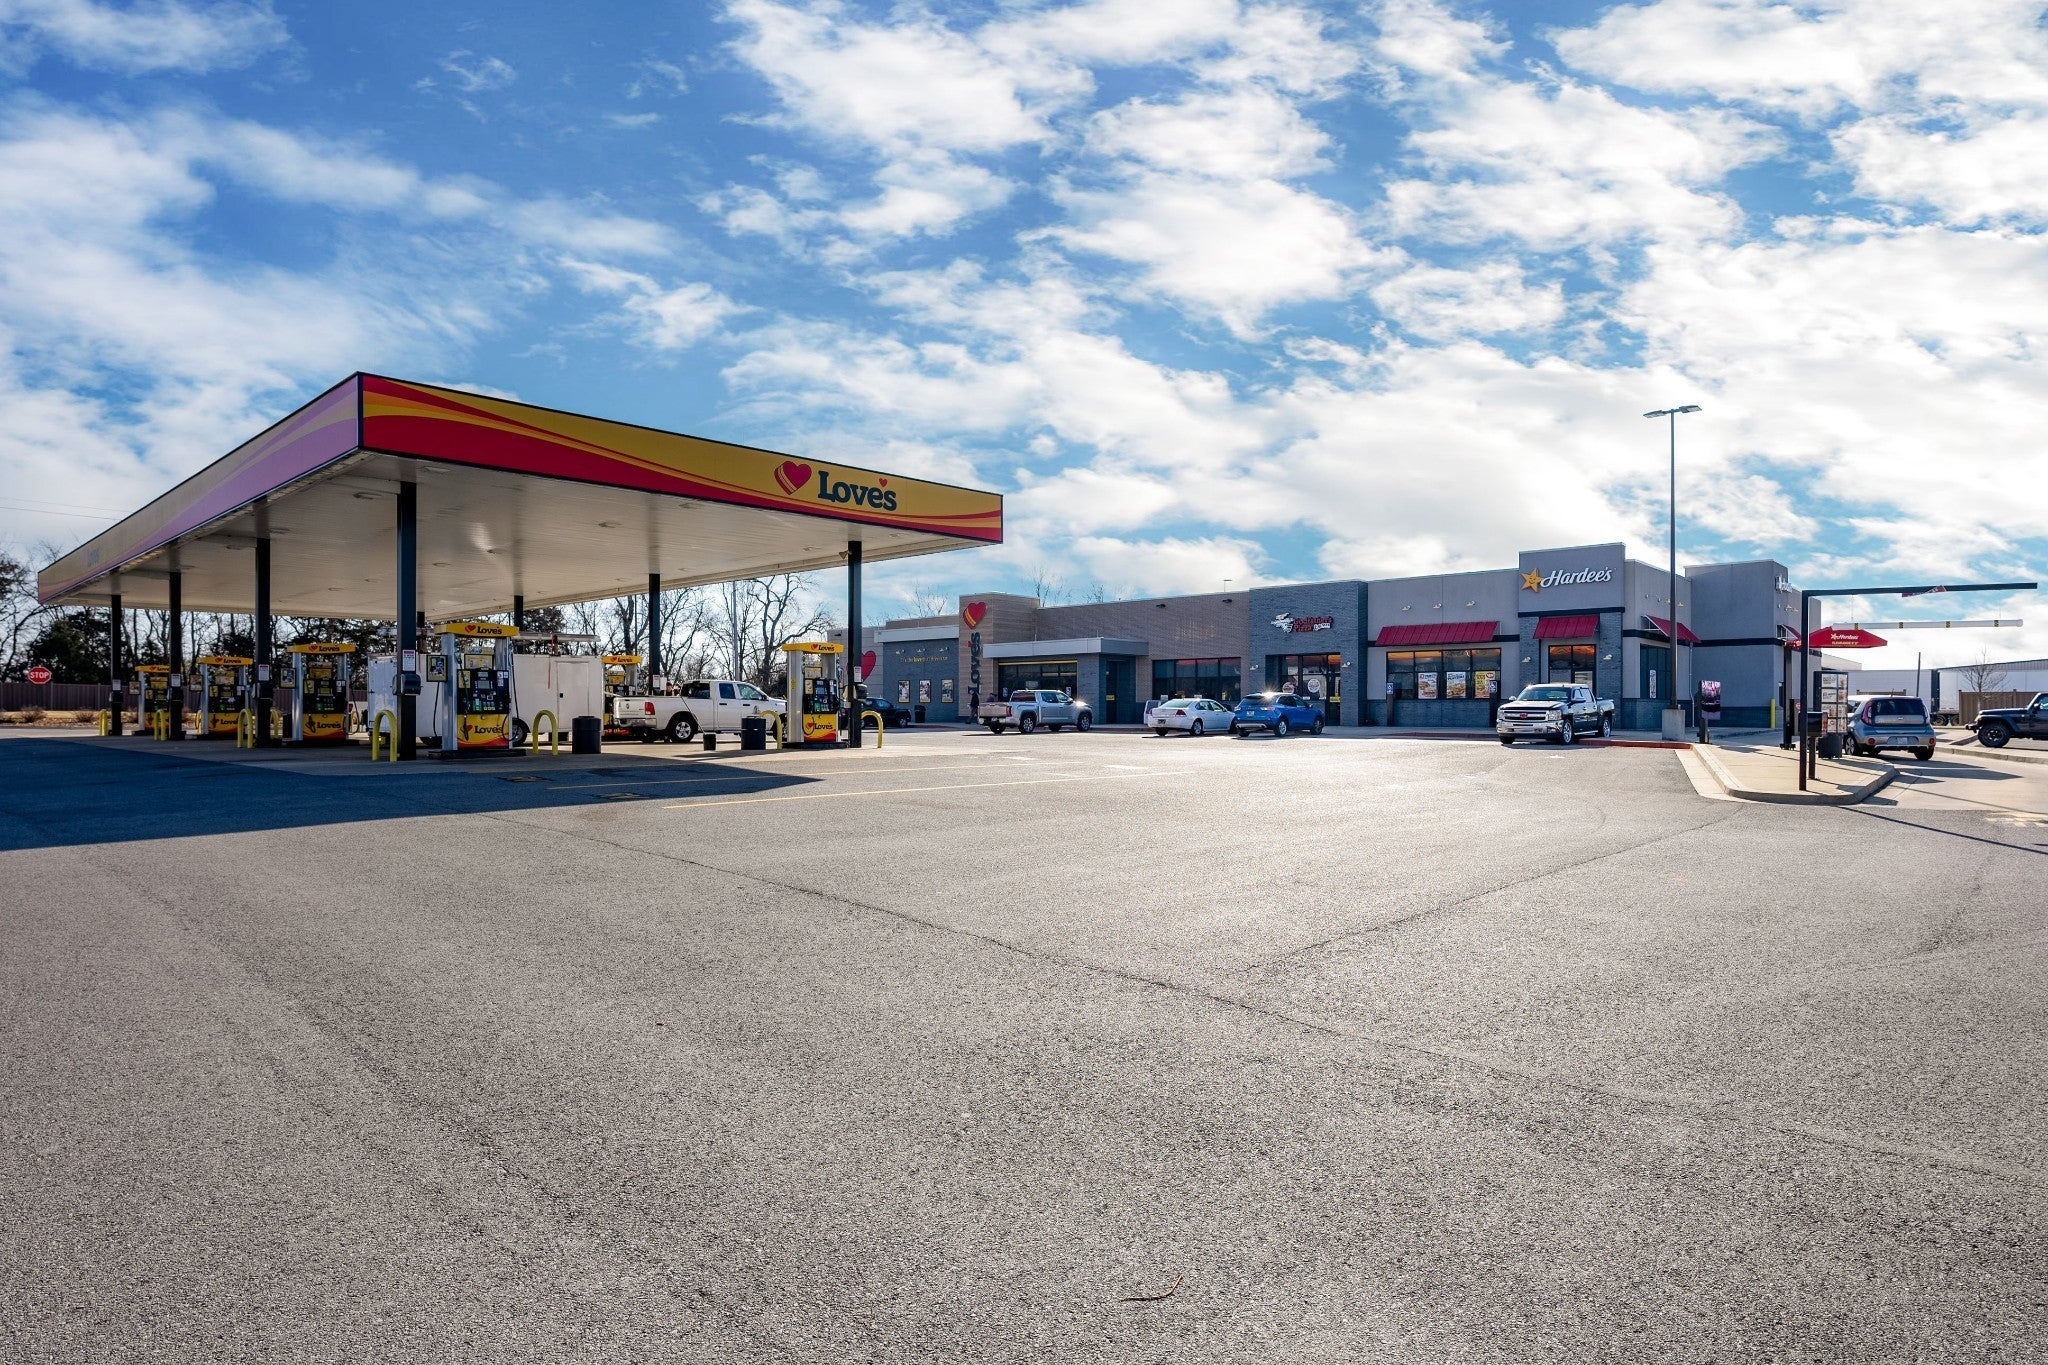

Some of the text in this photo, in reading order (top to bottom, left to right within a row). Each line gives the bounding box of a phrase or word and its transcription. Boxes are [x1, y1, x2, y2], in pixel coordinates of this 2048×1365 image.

[1540, 567, 1612, 588] Hardee's
[1293, 624, 1312, 632] Pizza
[30, 671, 49, 679] STOP
